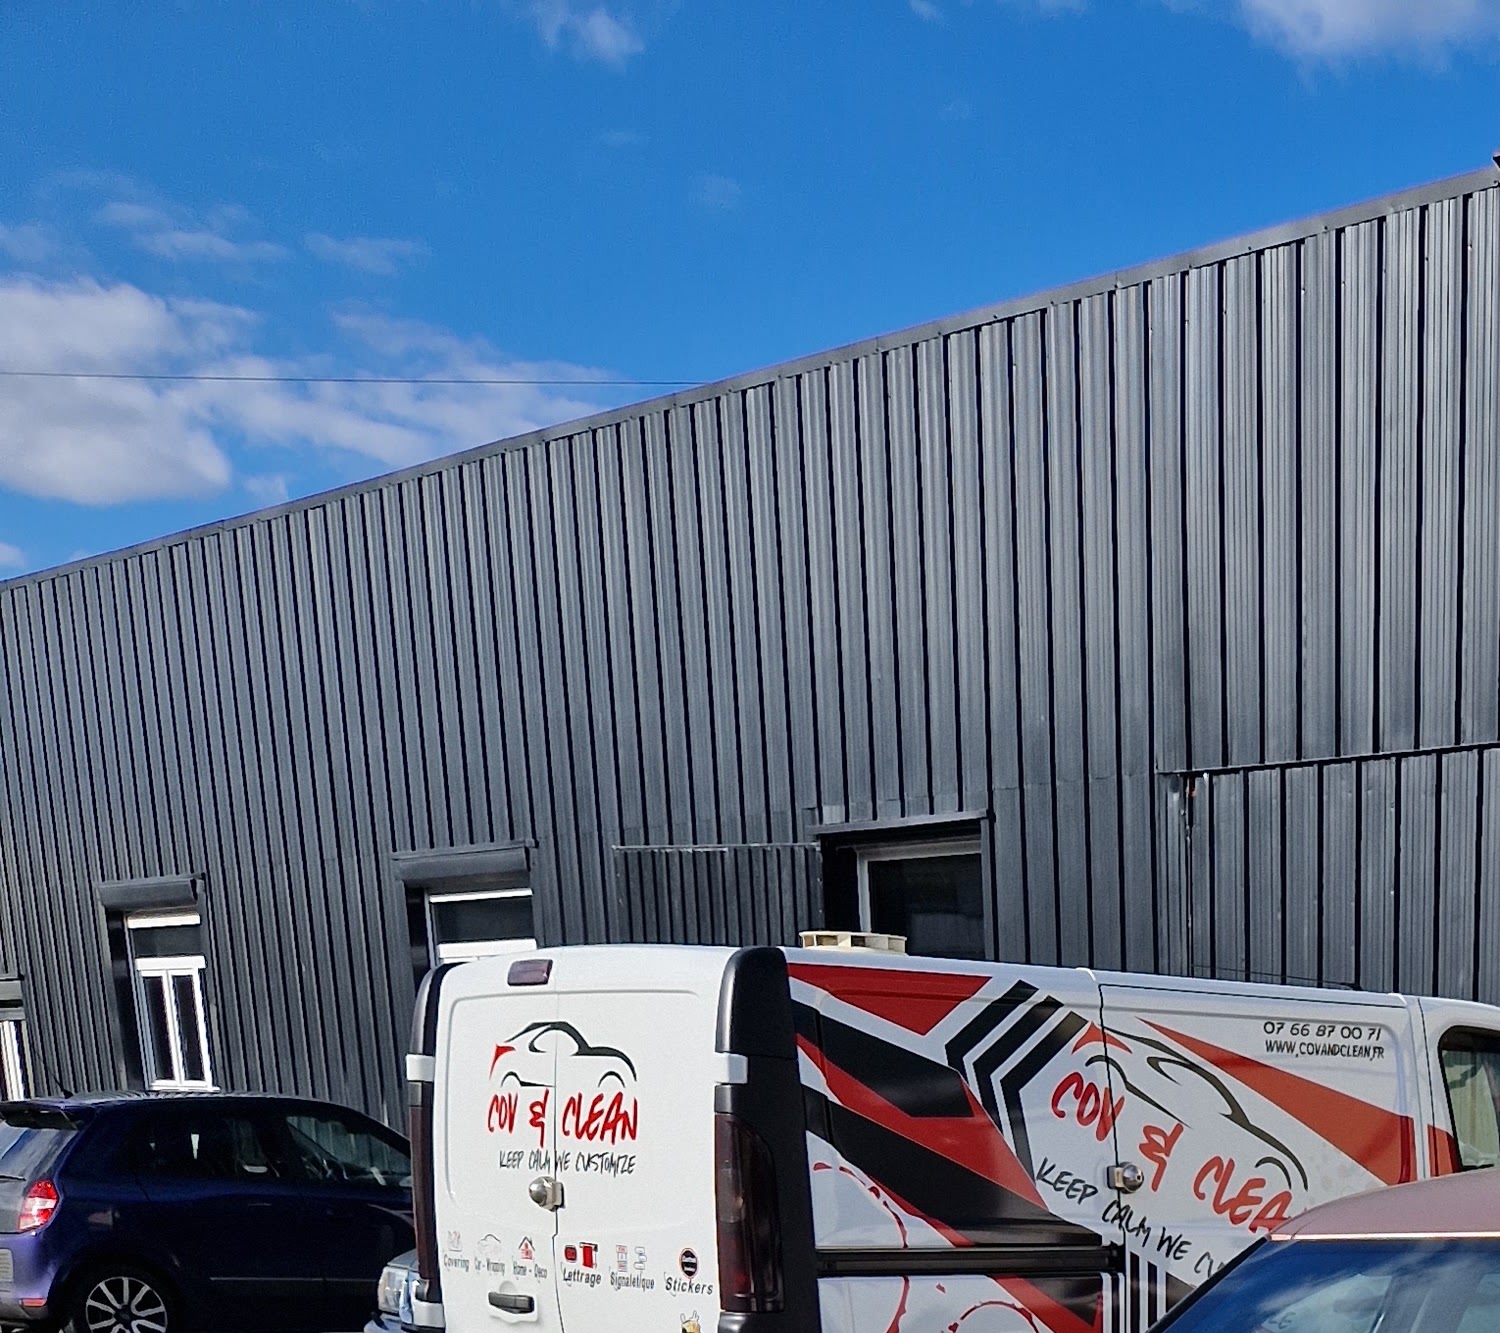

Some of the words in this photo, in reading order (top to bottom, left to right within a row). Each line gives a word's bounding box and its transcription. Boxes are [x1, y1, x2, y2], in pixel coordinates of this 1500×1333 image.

[1263, 1021, 1285, 1035] 07
[1290, 1023, 1310, 1037] 66
[1315, 1024, 1335, 1038] 87
[1340, 1026, 1362, 1039] 00
[1367, 1027, 1381, 1041] 71
[1265, 1039, 1384, 1061] WWW.COVANDCLEAN.FR
[488, 1092, 518, 1134] COV
[529, 1088, 549, 1149] &
[562, 1091, 638, 1146] CLEAN
[500, 1150, 524, 1169] KEEP
[528, 1149, 551, 1172] CALM
[555, 1150, 571, 1172] WE
[575, 1152, 636, 1178] CUSTOMIZE
[1051, 1071, 1125, 1142] COV
[1138, 1123, 1184, 1192] &
[1193, 1156, 1292, 1233] CLEA
[1036, 1157, 1099, 1205] KEEP
[1101, 1199, 1152, 1248] CALM
[1156, 1227, 1193, 1261] WE
[562, 1266, 601, 1288] Lettrage
[664, 1275, 714, 1298] Stickers
